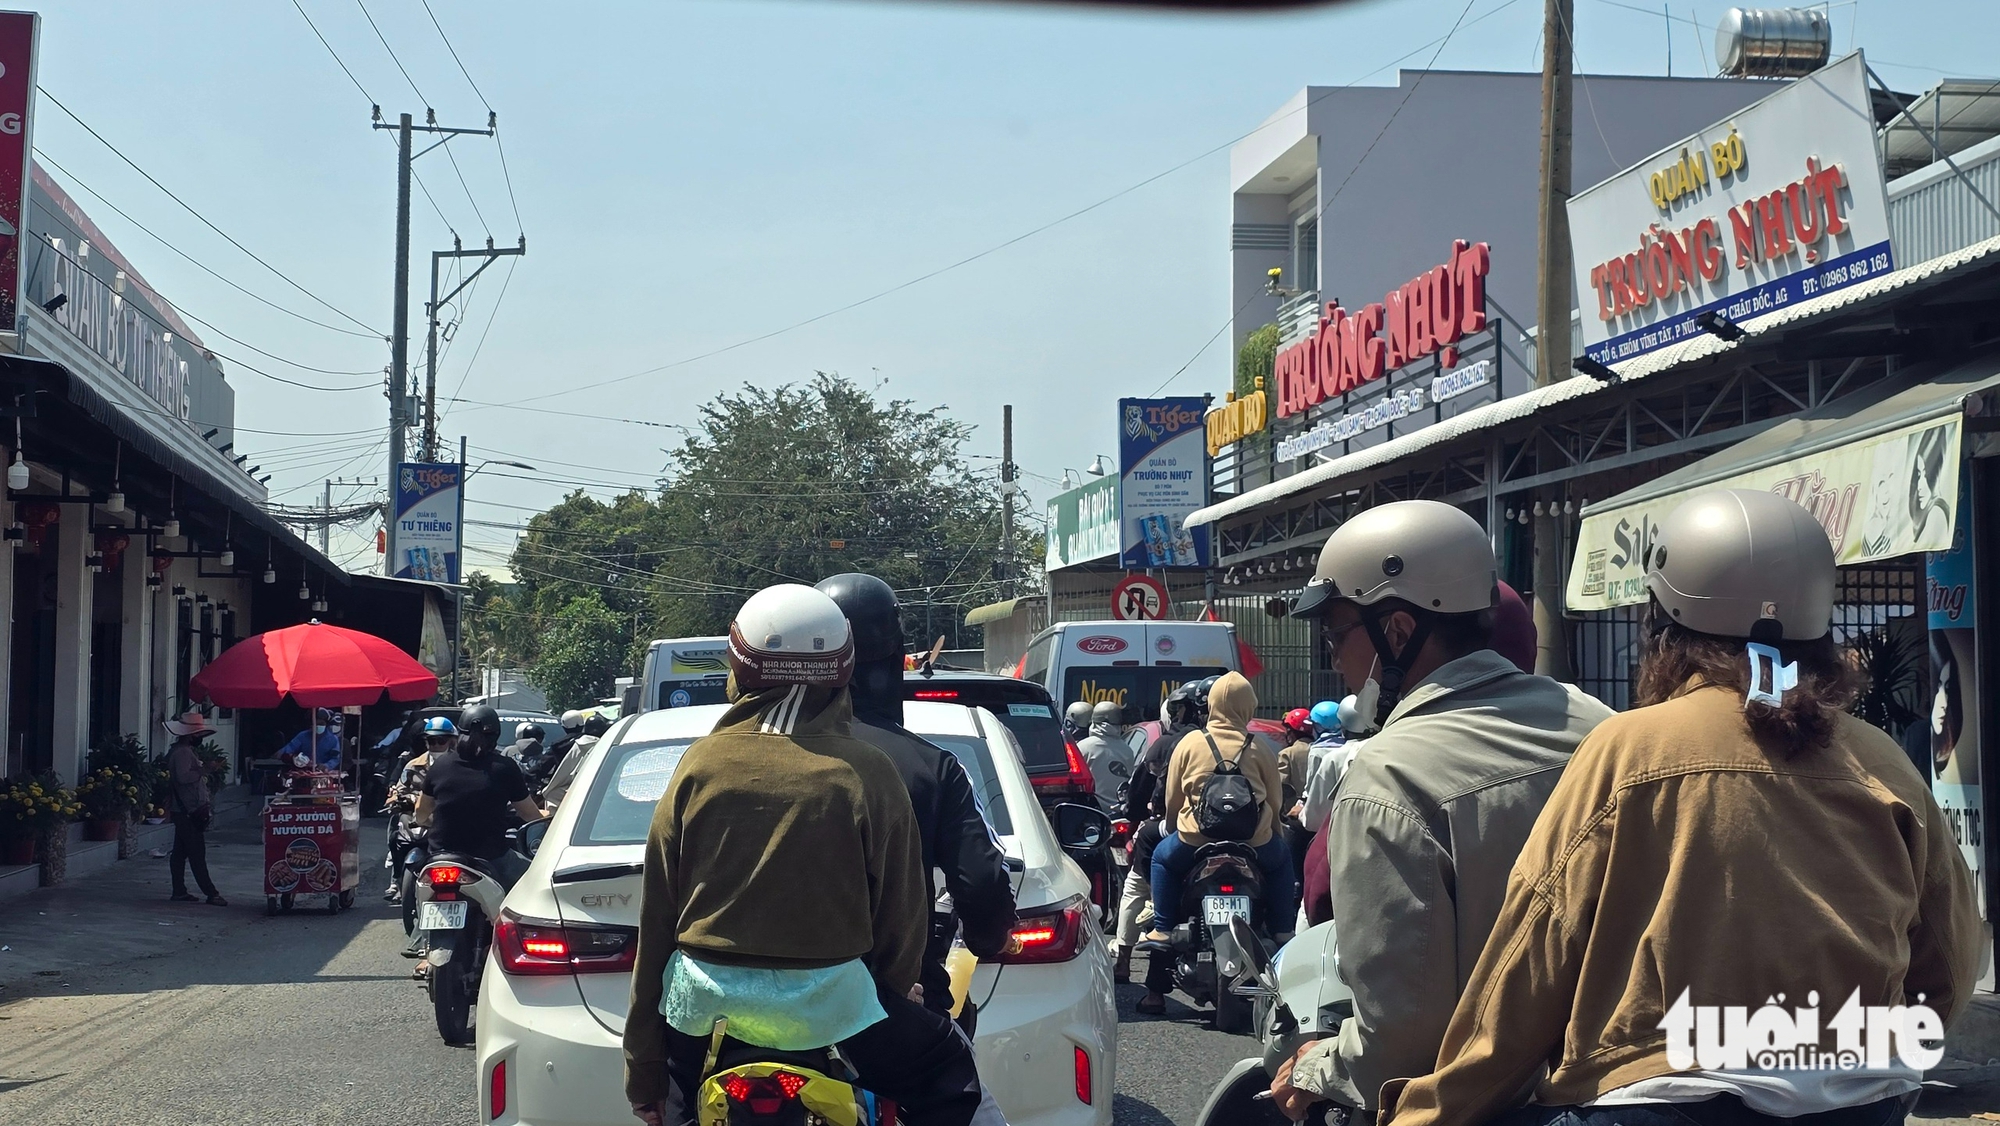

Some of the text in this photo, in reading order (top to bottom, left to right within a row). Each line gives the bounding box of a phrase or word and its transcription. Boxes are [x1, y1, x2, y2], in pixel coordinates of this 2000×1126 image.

[1650, 122, 1745, 210] QUÁN BÒ
[1591, 154, 1849, 321] TRƯỜNG NHỰT
[1619, 337, 1640, 358] KHÓM
[1658, 326, 1675, 342] TÂY,
[1675, 324, 1682, 338] P
[1729, 298, 1752, 321] CHÂU
[1753, 288, 1774, 313] ĐỐC,
[1775, 287, 1789, 306] AG
[1802, 278, 1819, 296] ĐT:
[1820, 266, 1848, 290] 02963
[1850, 260, 1869, 281] 862
[1870, 252, 1889, 272] 162
[1274, 239, 1490, 419] TRƯỜNG NHỰT
[1146, 404, 1201, 432] Tiger
[1207, 389, 1244, 457] QUÁN
[1149, 457, 1177, 468] QUÁN BÒ
[416, 468, 457, 489] Tiger
[1133, 469, 1193, 483] TRƯỜNG NHỰT
[401, 519, 452, 532] TƯ THIÊNG
[1086, 638, 1118, 651] Ford
[762, 661, 779, 669] NHA
[780, 661, 802, 669] KHOA
[803, 661, 828, 669] THANH
[270, 813, 293, 824] LẠP
[1963, 801, 1980, 847] TÓC
[581, 892, 633, 907] CITY
[425, 915, 461, 928] 114.30
